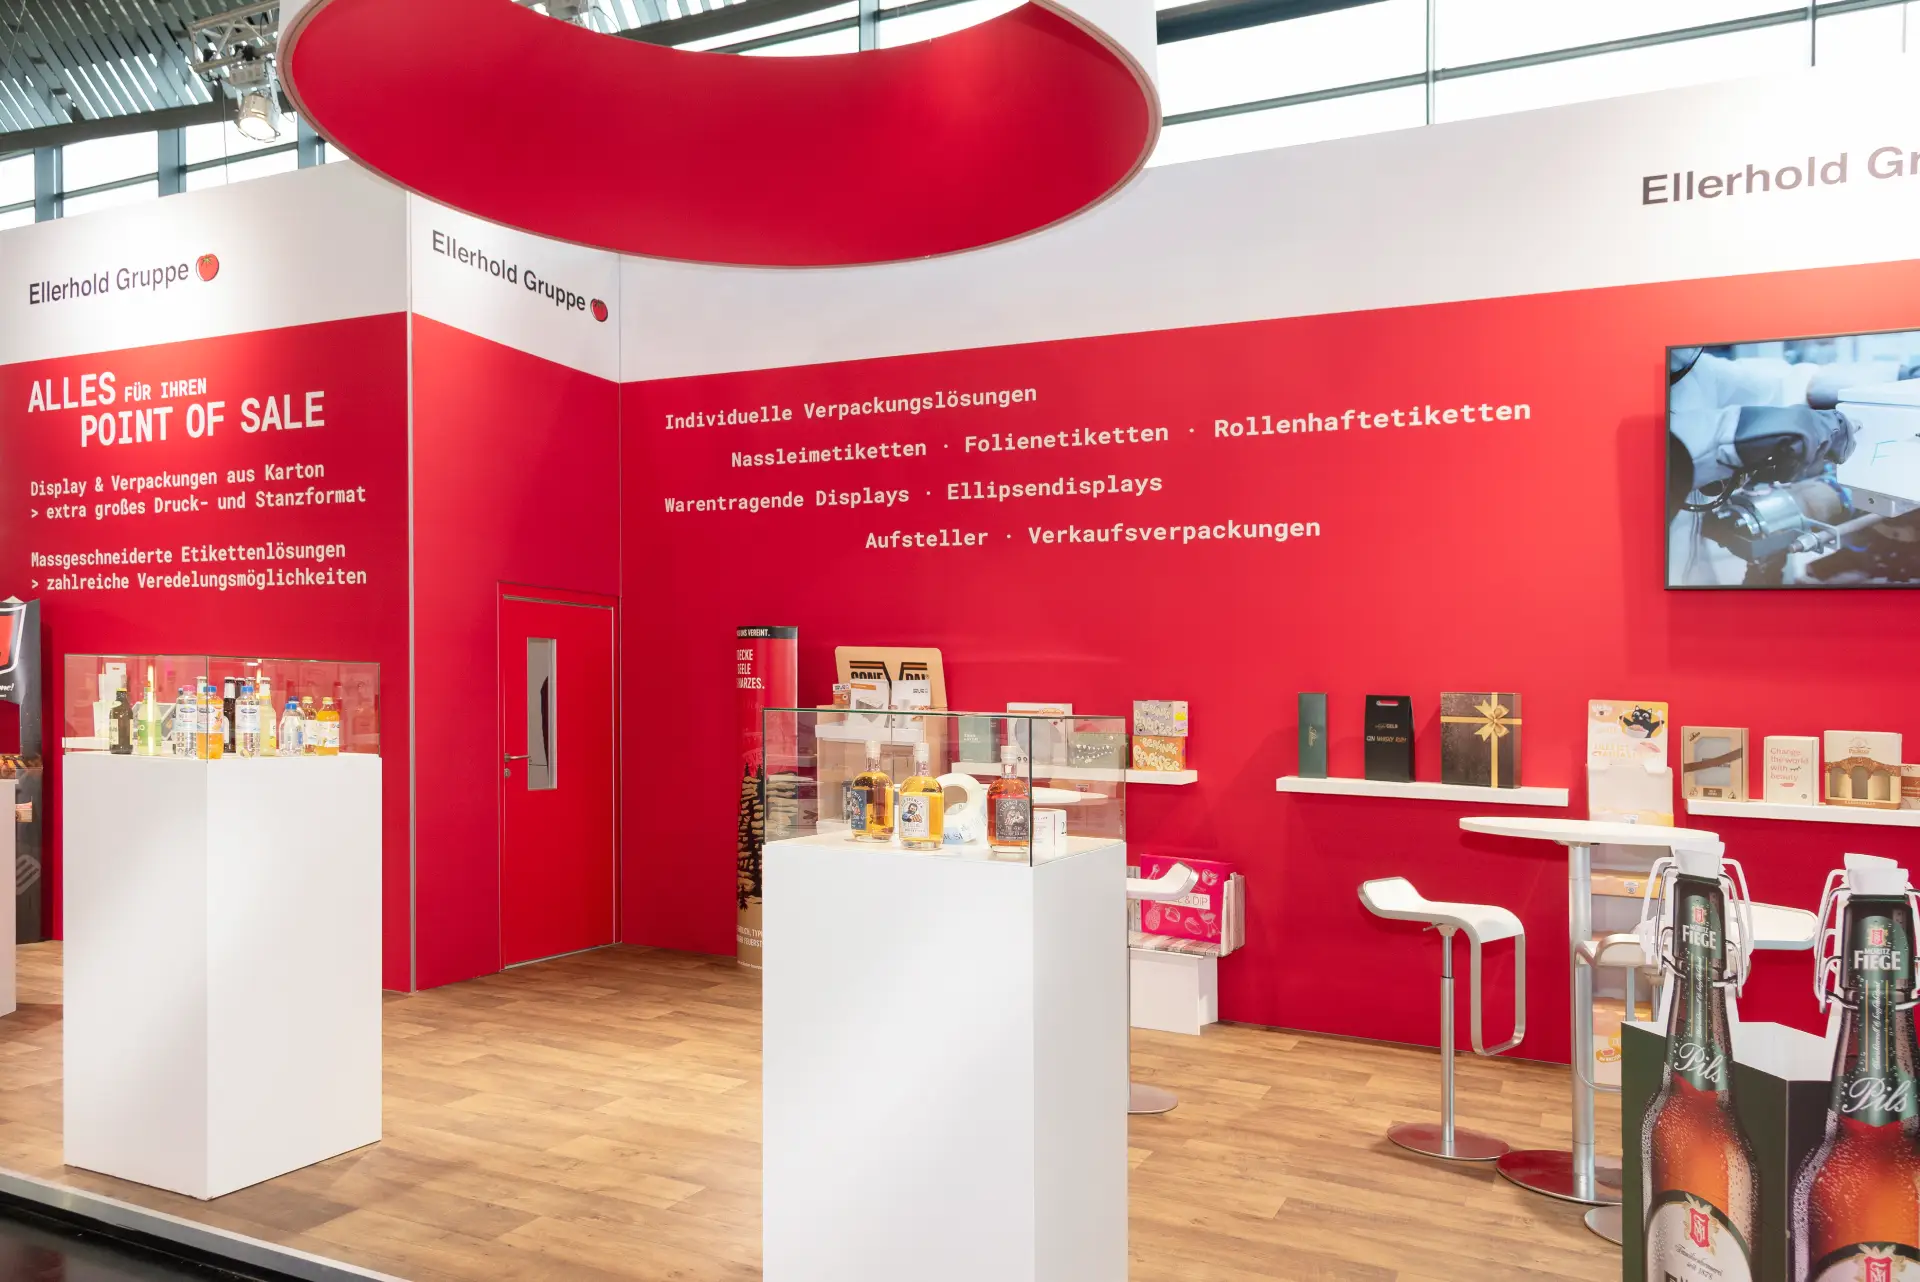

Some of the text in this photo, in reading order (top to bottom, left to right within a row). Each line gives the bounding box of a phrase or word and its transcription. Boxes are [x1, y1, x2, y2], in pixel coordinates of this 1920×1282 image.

[1643, 153, 1847, 205] Ellerhold
[30, 264, 188, 304] Ellerhold Gruppe
[433, 230, 585, 310] Ellerhold Gruppe
[28, 372, 206, 412] ALLES FÜR IHREN
[666, 388, 1036, 429] Individuelle Verpackungslösungen
[81, 391, 324, 447] POINT OF SALE
[732, 404, 1530, 467] Nassleimetiketten Folienetiketten Rollenhaftetiketten
[31, 463, 324, 498] Display & Verpackungen aus Karton
[665, 475, 1162, 513] Warentragende Displays Ellipsendisplays
[47, 504, 86, 519] extra
[95, 498, 145, 520] großes
[155, 495, 208, 513] Druck-
[218, 491, 245, 509] und
[256, 486, 365, 507] Stanzformat
[866, 520, 1320, 548] Aufsteller Verkaufsverpackungen
[32, 542, 345, 569] Massgeschneiderte Etikettenlösungen
[47, 573, 129, 590] zahlreiche
[138, 568, 366, 591] Veredelungsmöglichkeiten
[1192, 895, 1209, 906] DIP
[1682, 924, 1717, 950] FIEGE
[1854, 950, 1902, 971] FIEGE
[1674, 1042, 1722, 1083] Pils
[1842, 1077, 1912, 1113] Pils
